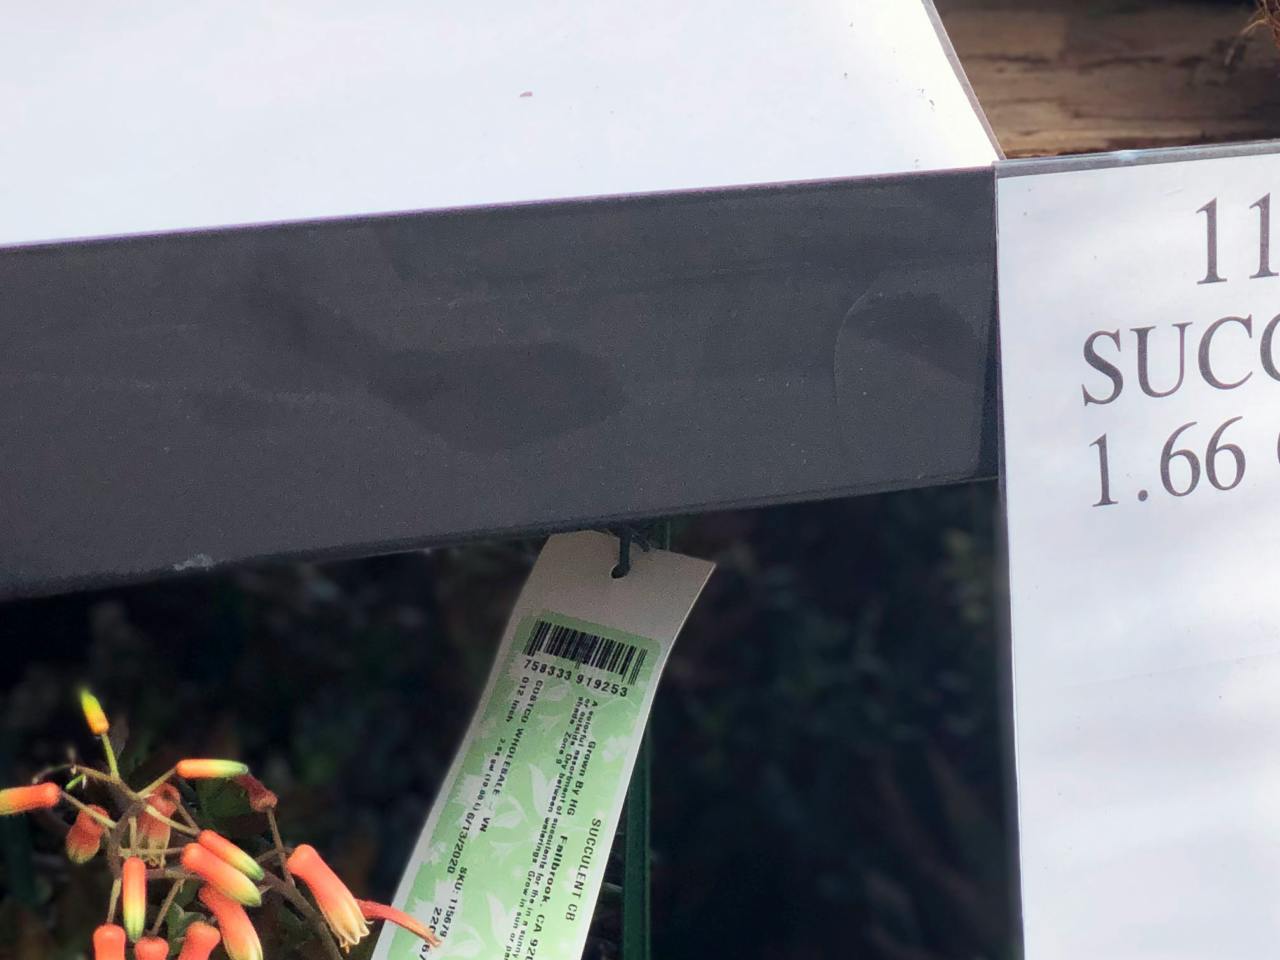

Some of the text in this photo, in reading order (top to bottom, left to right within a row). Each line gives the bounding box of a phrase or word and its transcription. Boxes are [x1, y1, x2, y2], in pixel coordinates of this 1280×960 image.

[1091, 417, 1247, 508] 1.66
[523, 659, 627, 697] 758333 919253
[583, 698, 591, 709] or
[591, 700, 599, 708] A
[577, 710, 594, 748] colorful
[479, 679, 544, 833] COSTCO WHOLESALE VN
[558, 731, 573, 756] Zone
[560, 753, 573, 771] Dry
[578, 740, 597, 777] Grown
[559, 749, 581, 804] assortment
[571, 780, 585, 796] By
[547, 772, 566, 813] between
[555, 805, 563, 816] of
[566, 798, 579, 816] HG
[446, 811, 476, 875] 6/13/2020
[538, 817, 559, 870] succulents
[534, 872, 545, 886] for
[565, 817, 602, 922] SUCCULENT CB
[522, 870, 536, 897] Grow
[439, 866, 468, 938] SKU: 115679
[519, 898, 528, 908] in
[529, 889, 539, 905] the
[512, 911, 522, 930] sun
[525, 907, 534, 917] in
[532, 914, 545, 933] CA
[509, 932, 516, 943] or
[511, 929, 526, 959] sunny
